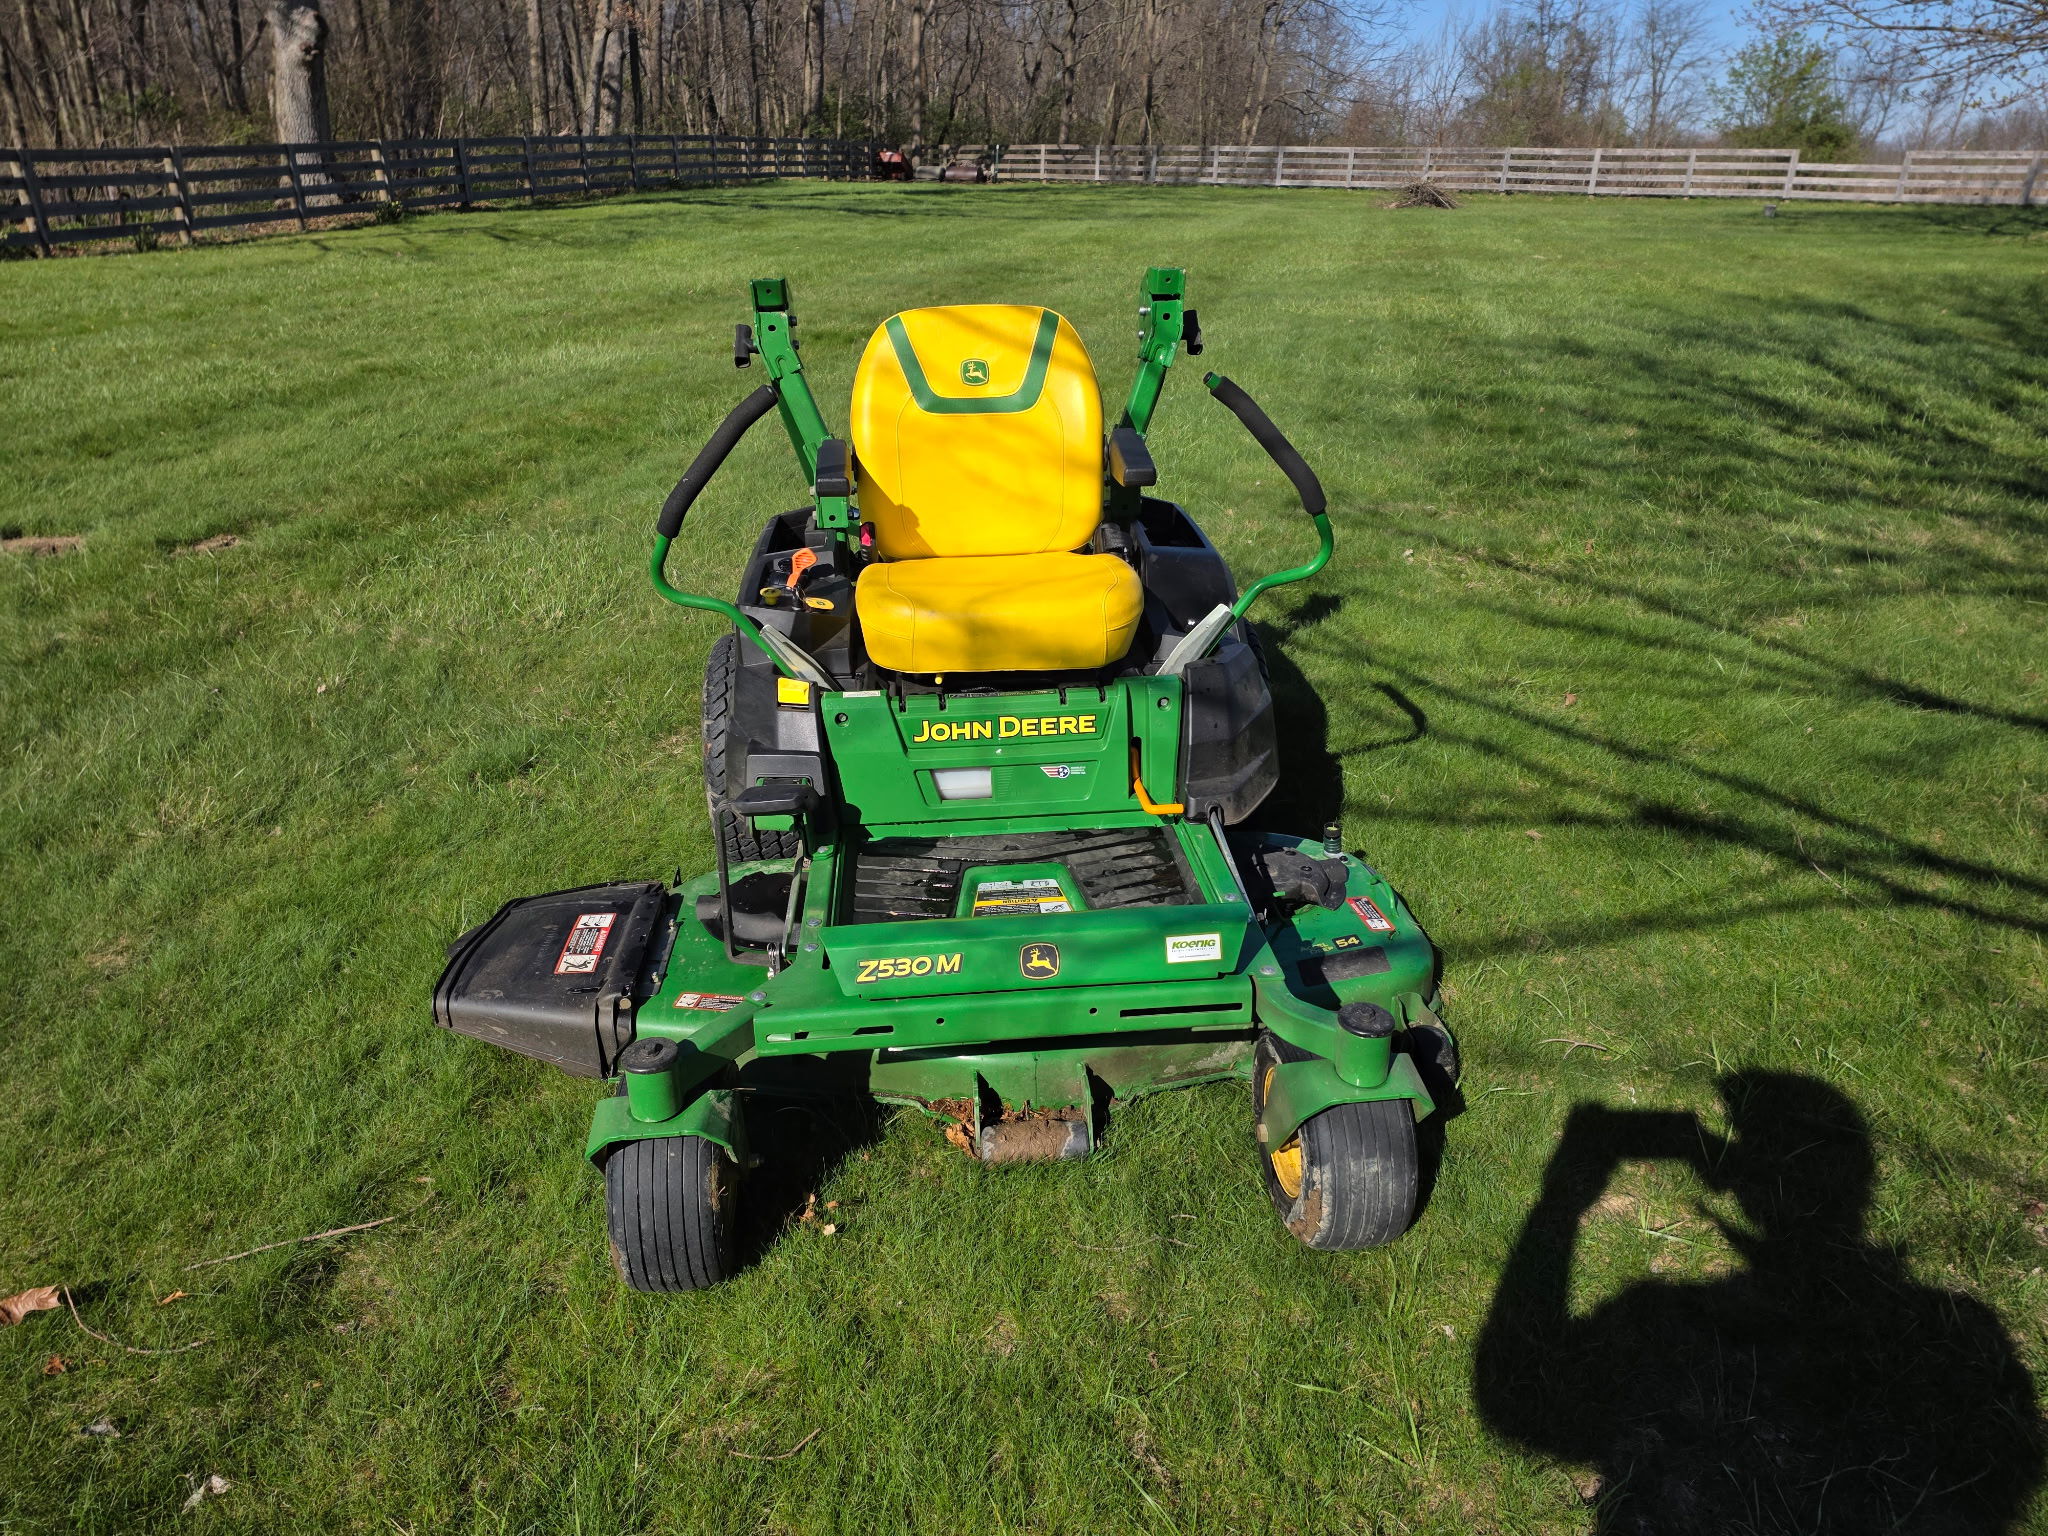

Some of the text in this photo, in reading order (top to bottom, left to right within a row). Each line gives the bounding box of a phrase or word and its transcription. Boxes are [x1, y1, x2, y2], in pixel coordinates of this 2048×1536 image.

[913, 715, 1097, 743] JOHN DEERE
[1335, 936, 1360, 948] 54
